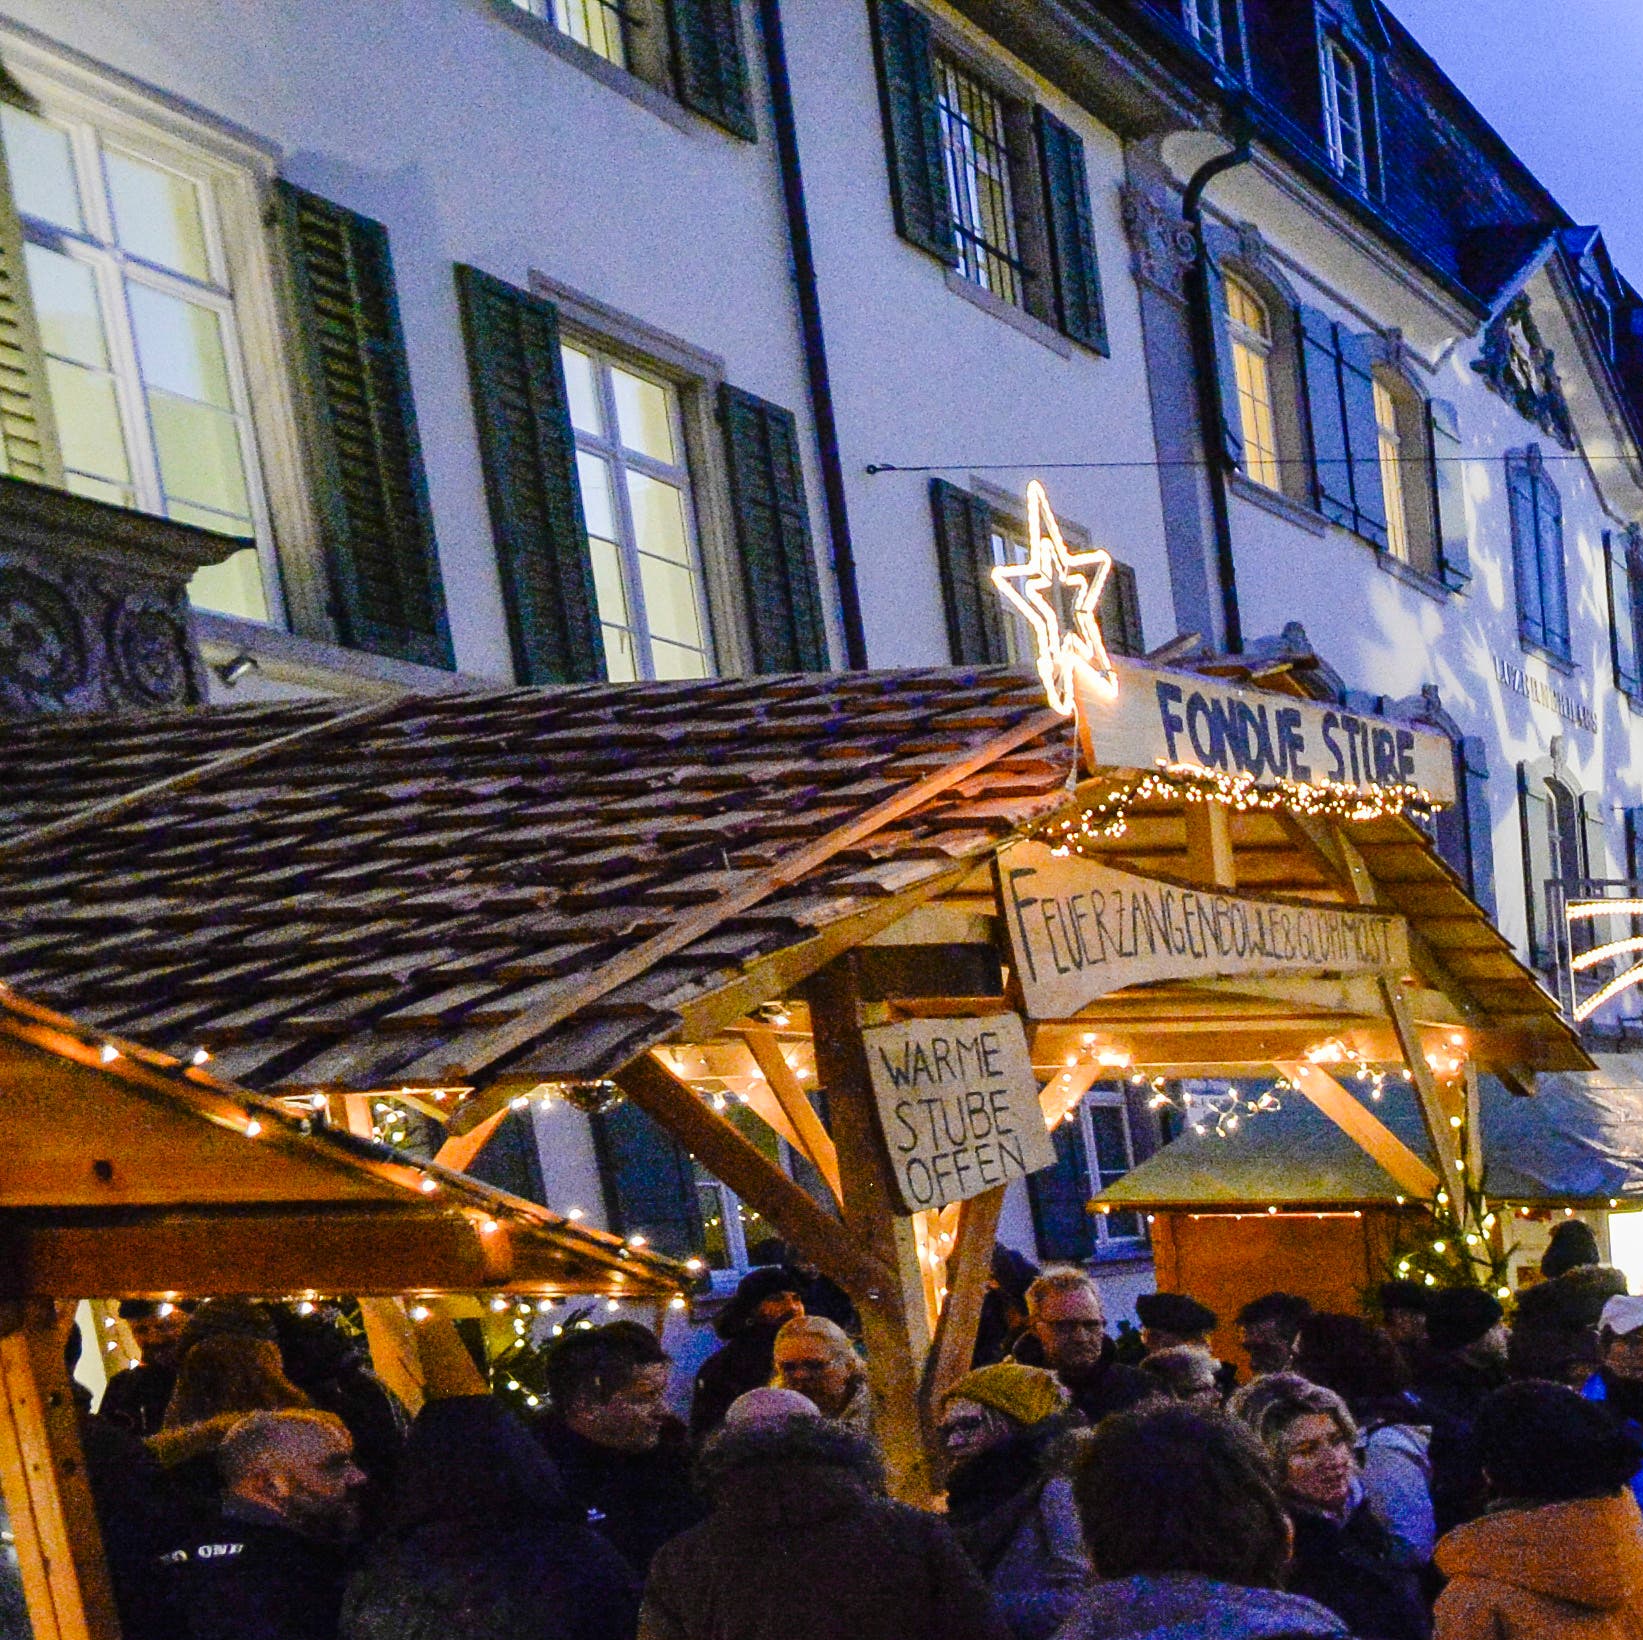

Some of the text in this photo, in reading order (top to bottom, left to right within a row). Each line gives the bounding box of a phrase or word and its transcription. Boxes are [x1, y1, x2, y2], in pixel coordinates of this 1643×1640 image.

[1156, 680, 1418, 790] FONDUE STUBE
[878, 1031, 1004, 1089] WARME
[895, 1089, 1014, 1154] STUBE
[906, 1135, 1027, 1204] OFFEN
